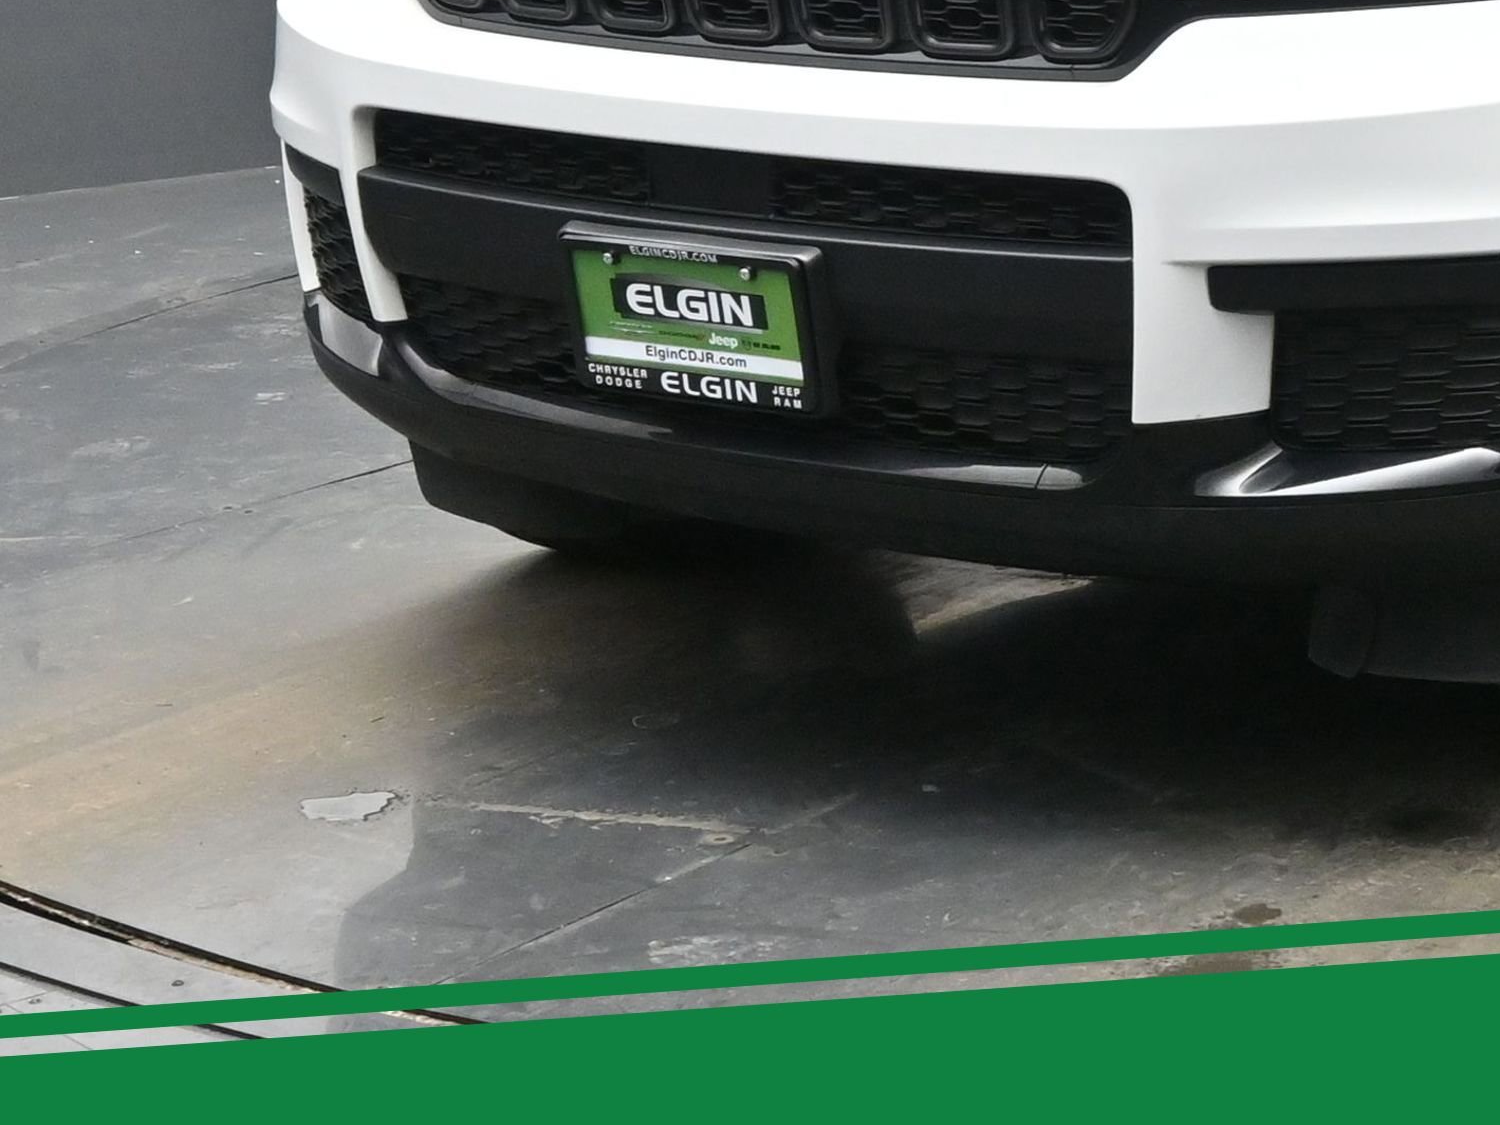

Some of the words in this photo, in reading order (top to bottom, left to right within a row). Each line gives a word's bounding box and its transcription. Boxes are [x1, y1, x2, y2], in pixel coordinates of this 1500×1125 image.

[625, 283, 754, 327] ELGIN
[708, 332, 739, 349] Jeep
[645, 344, 748, 368] ElginCDJR.com
[588, 362, 648, 379] CHRYSLER
[595, 375, 643, 390] DODGE
[660, 371, 758, 404] ELGIN
[771, 385, 801, 397] JEEP
[773, 397, 803, 409] RAM
